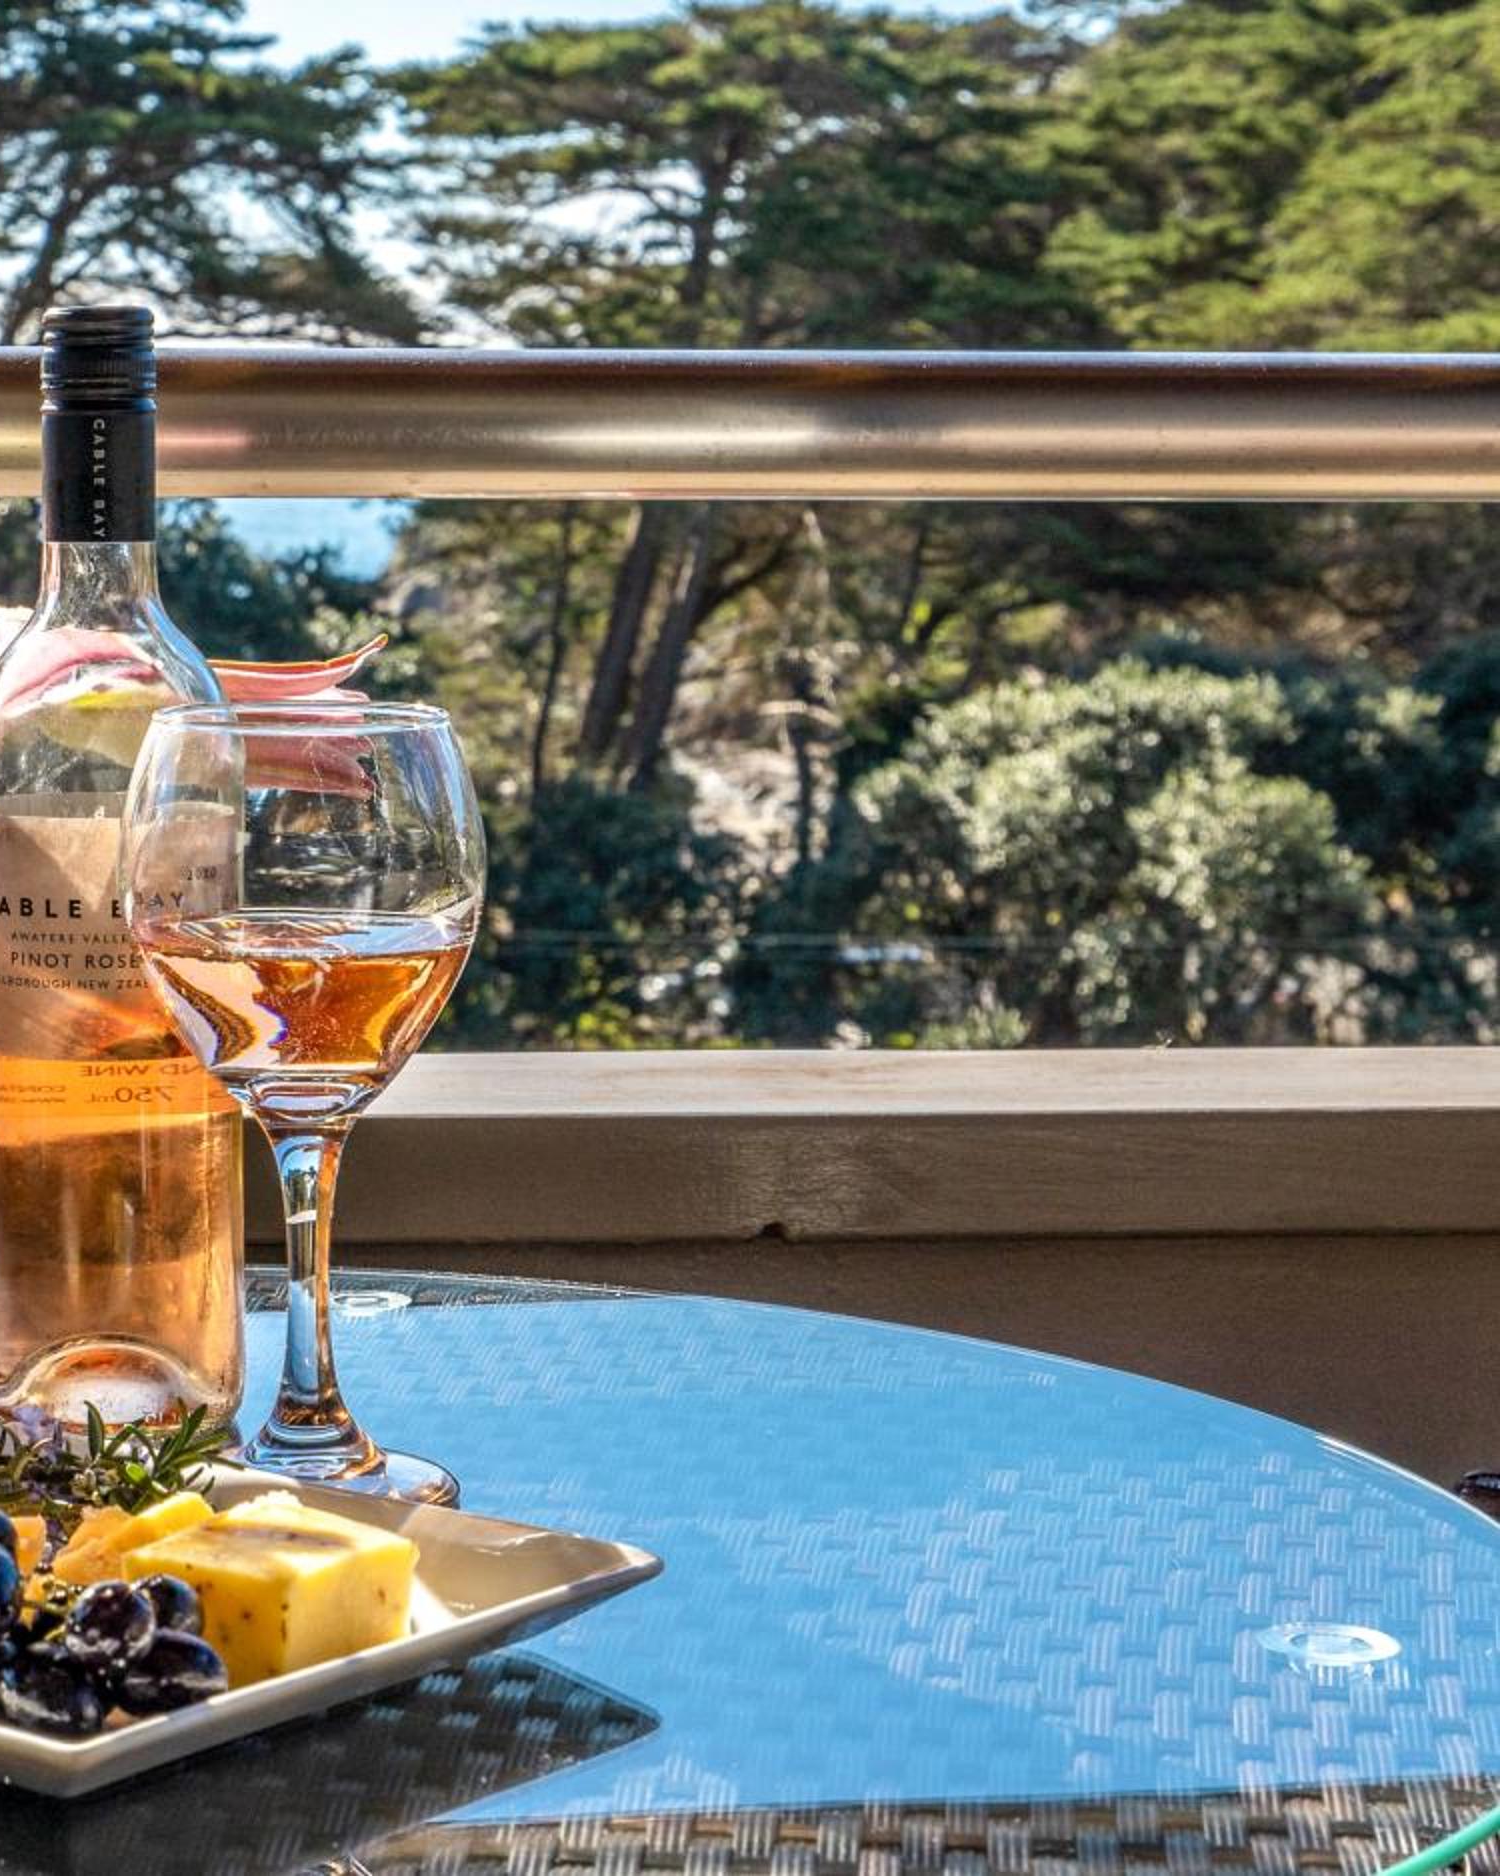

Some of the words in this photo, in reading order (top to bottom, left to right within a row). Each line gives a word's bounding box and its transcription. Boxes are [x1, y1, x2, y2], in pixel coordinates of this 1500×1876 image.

[92, 418, 106, 487] CABLE
[92, 499, 106, 537] BAY
[82, 932, 130, 945] VALLE
[11, 951, 73, 969] PINOT
[77, 978, 111, 990] NEW
